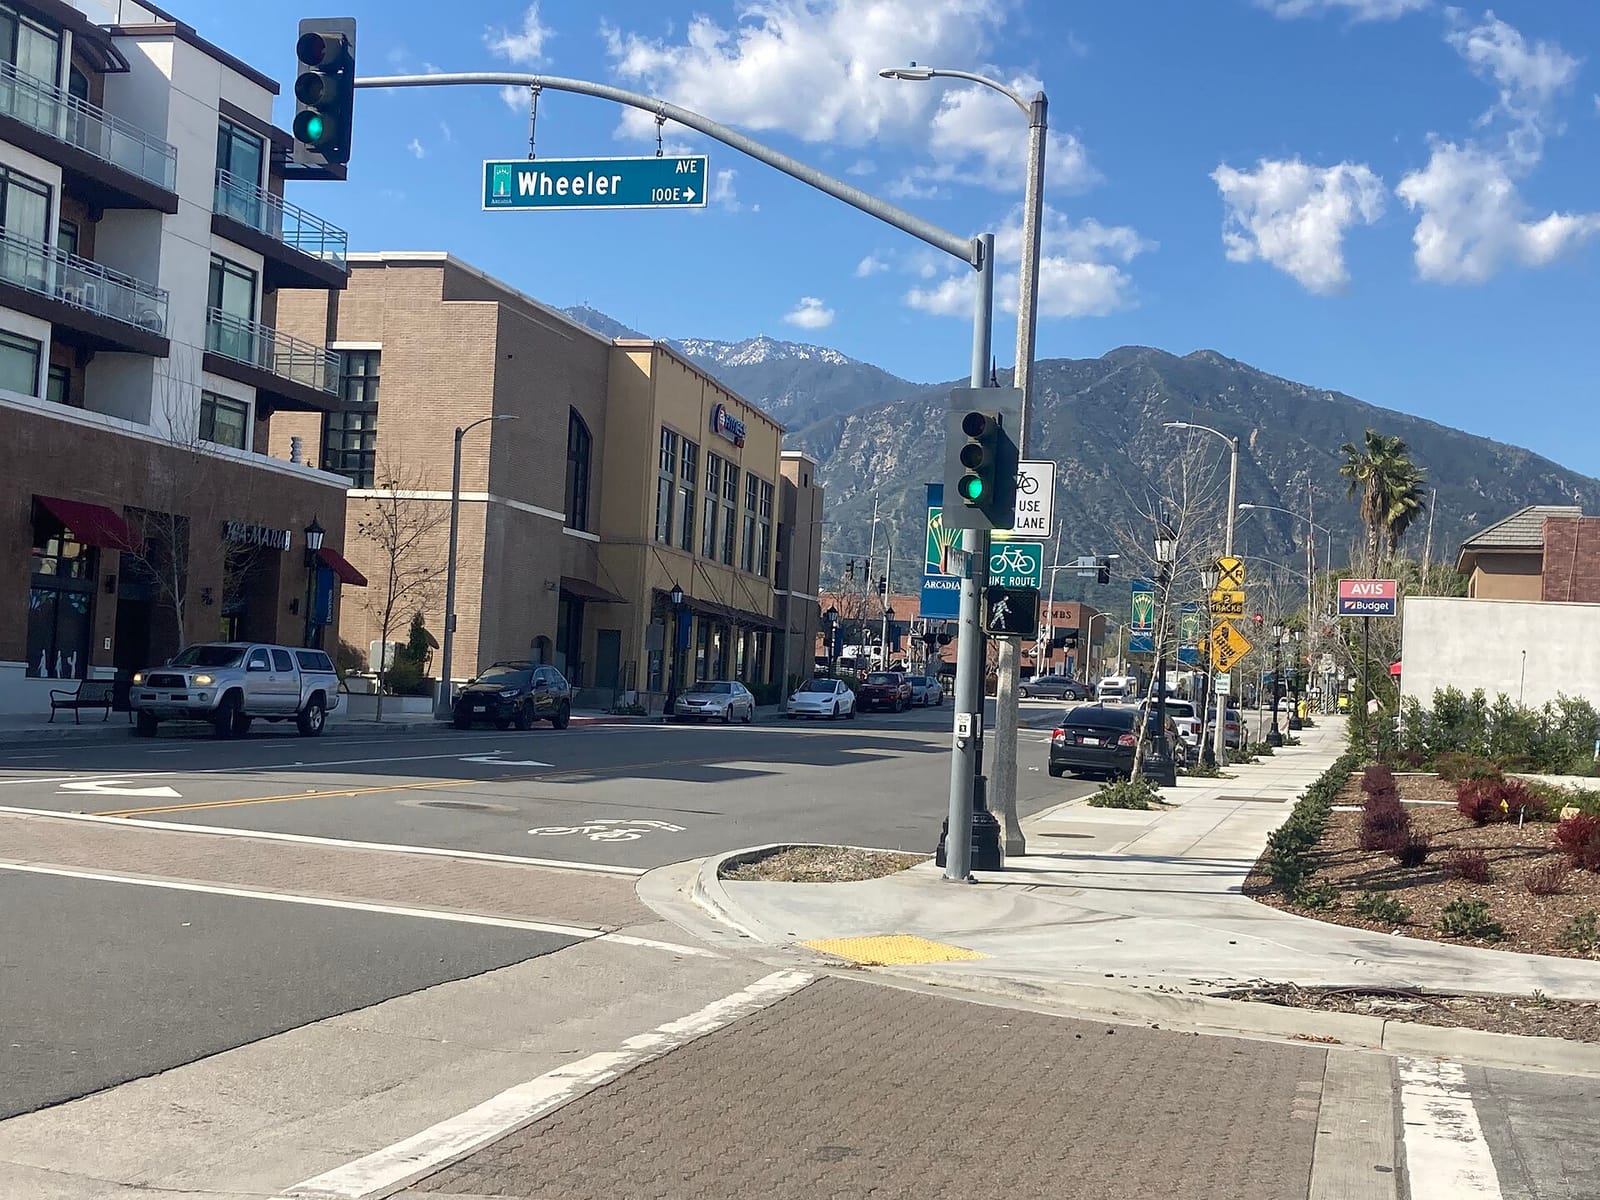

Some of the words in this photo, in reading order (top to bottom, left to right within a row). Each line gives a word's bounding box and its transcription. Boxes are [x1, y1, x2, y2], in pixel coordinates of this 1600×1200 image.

[675, 160, 697, 174] AVE
[518, 171, 622, 196] Wheeler
[651, 187, 681, 202] 100E
[1019, 500, 1041, 513] USE
[1017, 517, 1045, 529] LANE
[1235, 569, 1243, 579] R
[923, 579, 961, 590] ARCADIA
[1009, 576, 1036, 587] ROUTE
[1351, 583, 1384, 595] AVIS
[1223, 595, 1231, 604] 2
[1356, 601, 1389, 612] Budget
